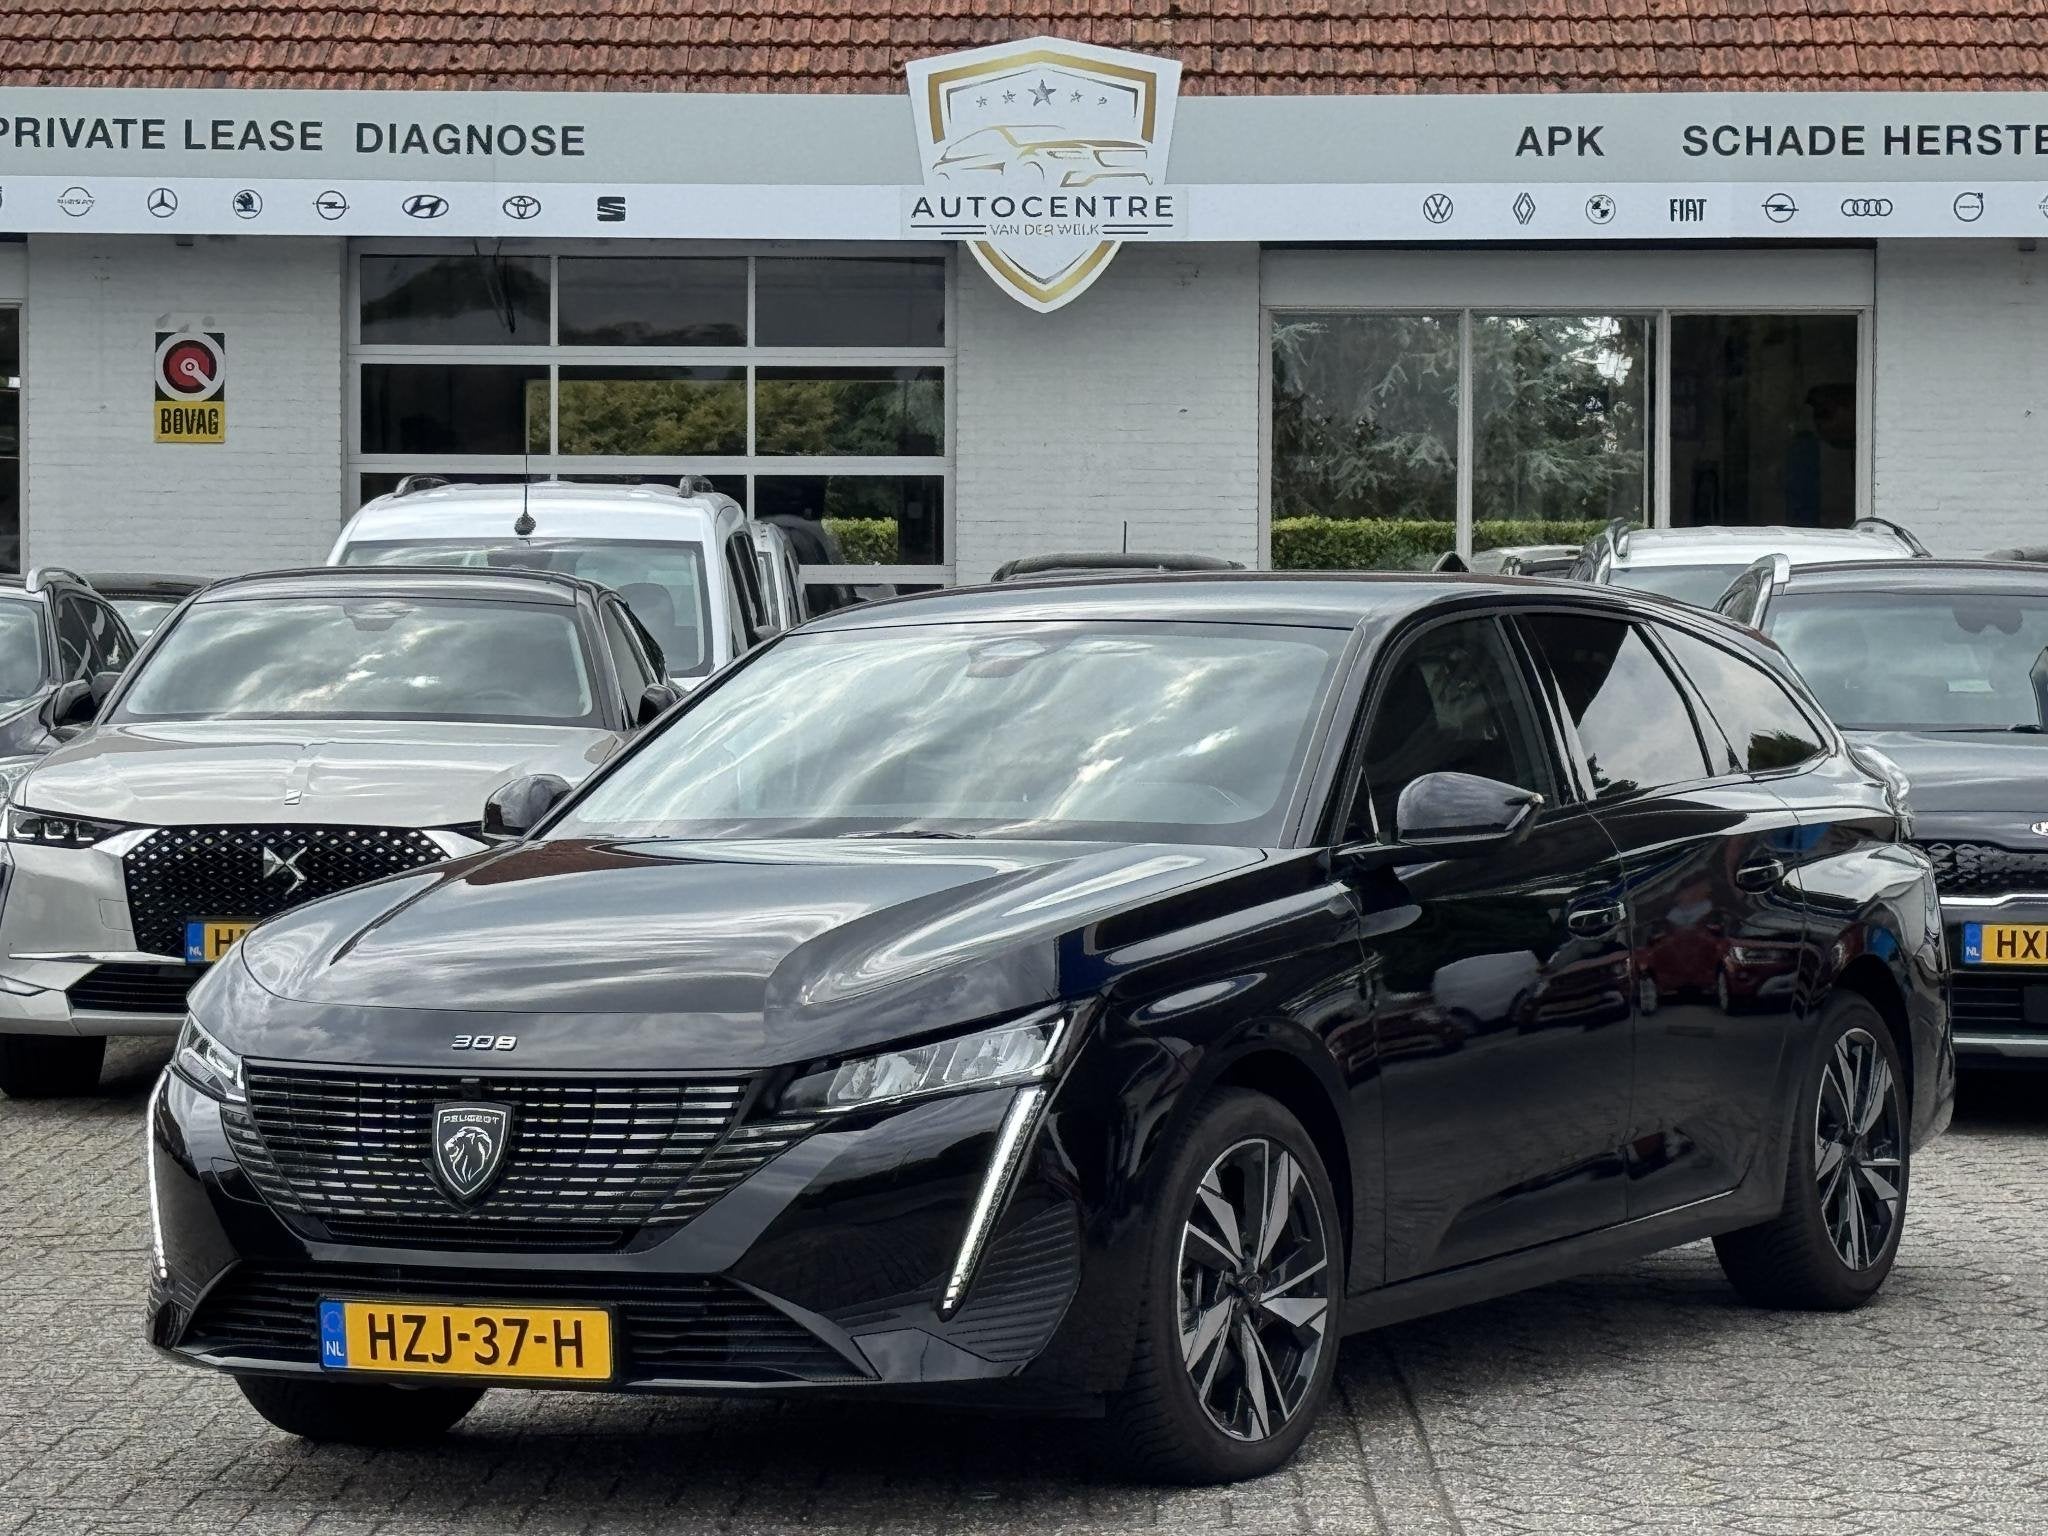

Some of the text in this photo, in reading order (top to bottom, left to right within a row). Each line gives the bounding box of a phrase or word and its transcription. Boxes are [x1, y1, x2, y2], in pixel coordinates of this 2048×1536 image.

[184, 119, 323, 151] LEASE
[355, 122, 585, 156] DIAGNOSE
[1515, 125, 1604, 157] APK
[1682, 125, 1865, 156] SCHADE
[911, 196, 1173, 218] AUTOCENTRE
[1669, 198, 1707, 222] FIAT
[990, 224, 1020, 236] VAN
[1024, 224, 1053, 236] DER
[160, 408, 218, 435] BOVAG
[1966, 946, 1980, 956] NL
[451, 1034, 517, 1051] 308
[442, 1114, 499, 1124] PEUGEOT
[326, 1340, 344, 1357] NL
[367, 1313, 584, 1368] HZJ-37-H
